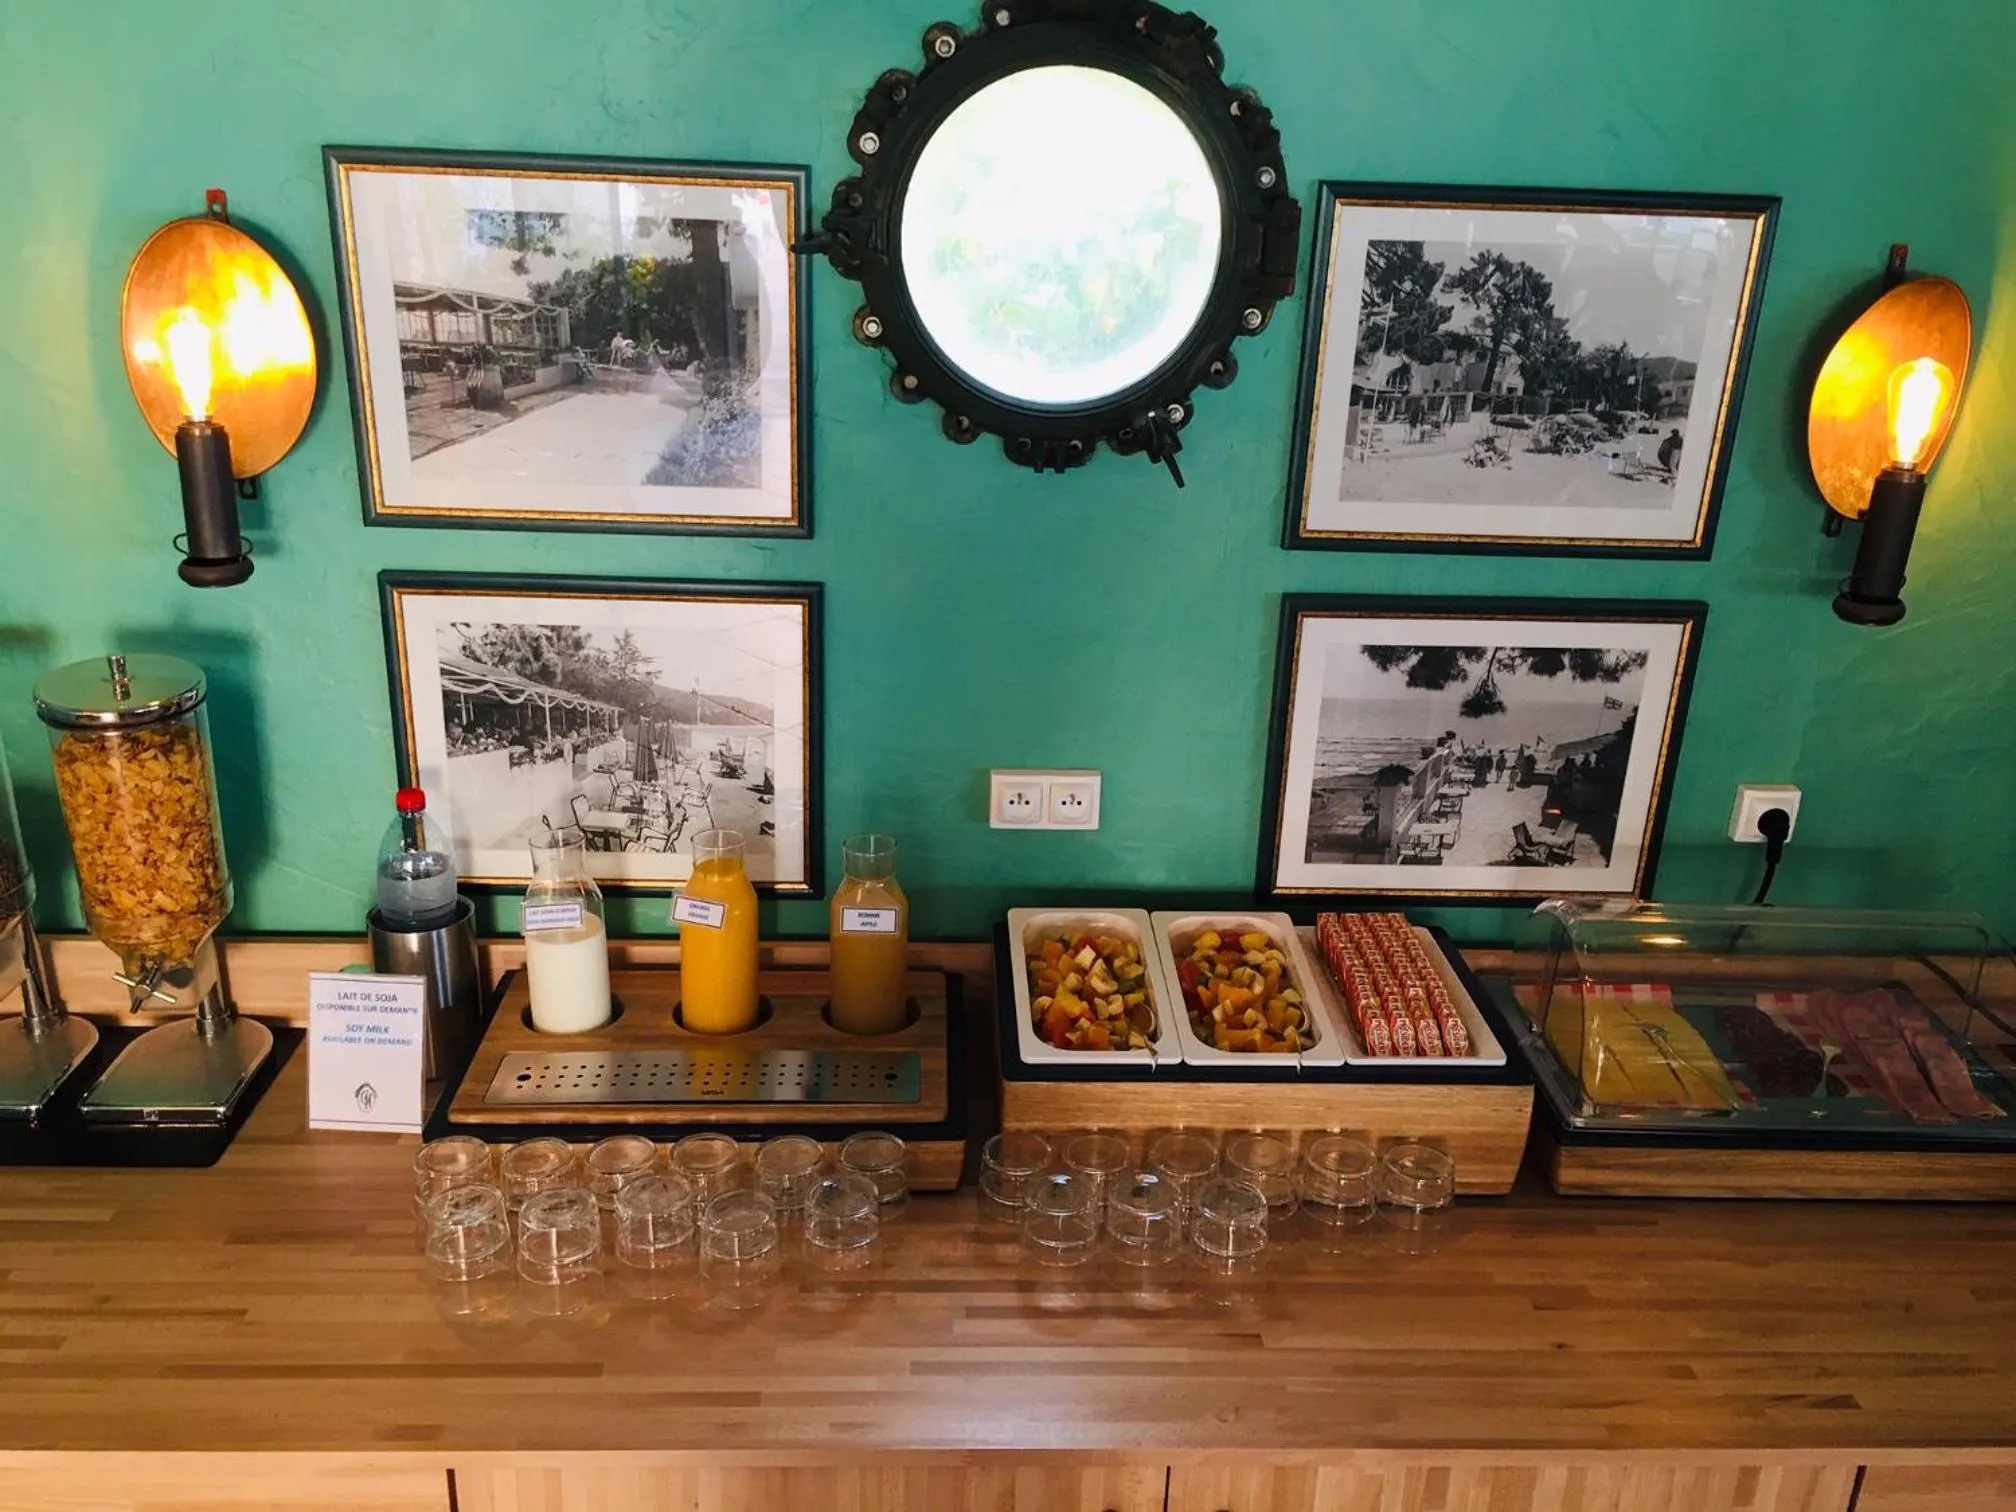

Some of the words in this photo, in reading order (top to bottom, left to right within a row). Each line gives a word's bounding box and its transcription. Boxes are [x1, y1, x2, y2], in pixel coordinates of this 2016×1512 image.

[338, 991, 357, 1001] LAIT
[360, 993, 372, 1001] DE
[375, 993, 398, 1002] SOJA
[346, 1023, 364, 1033] SOY
[366, 1025, 390, 1034] MILK
